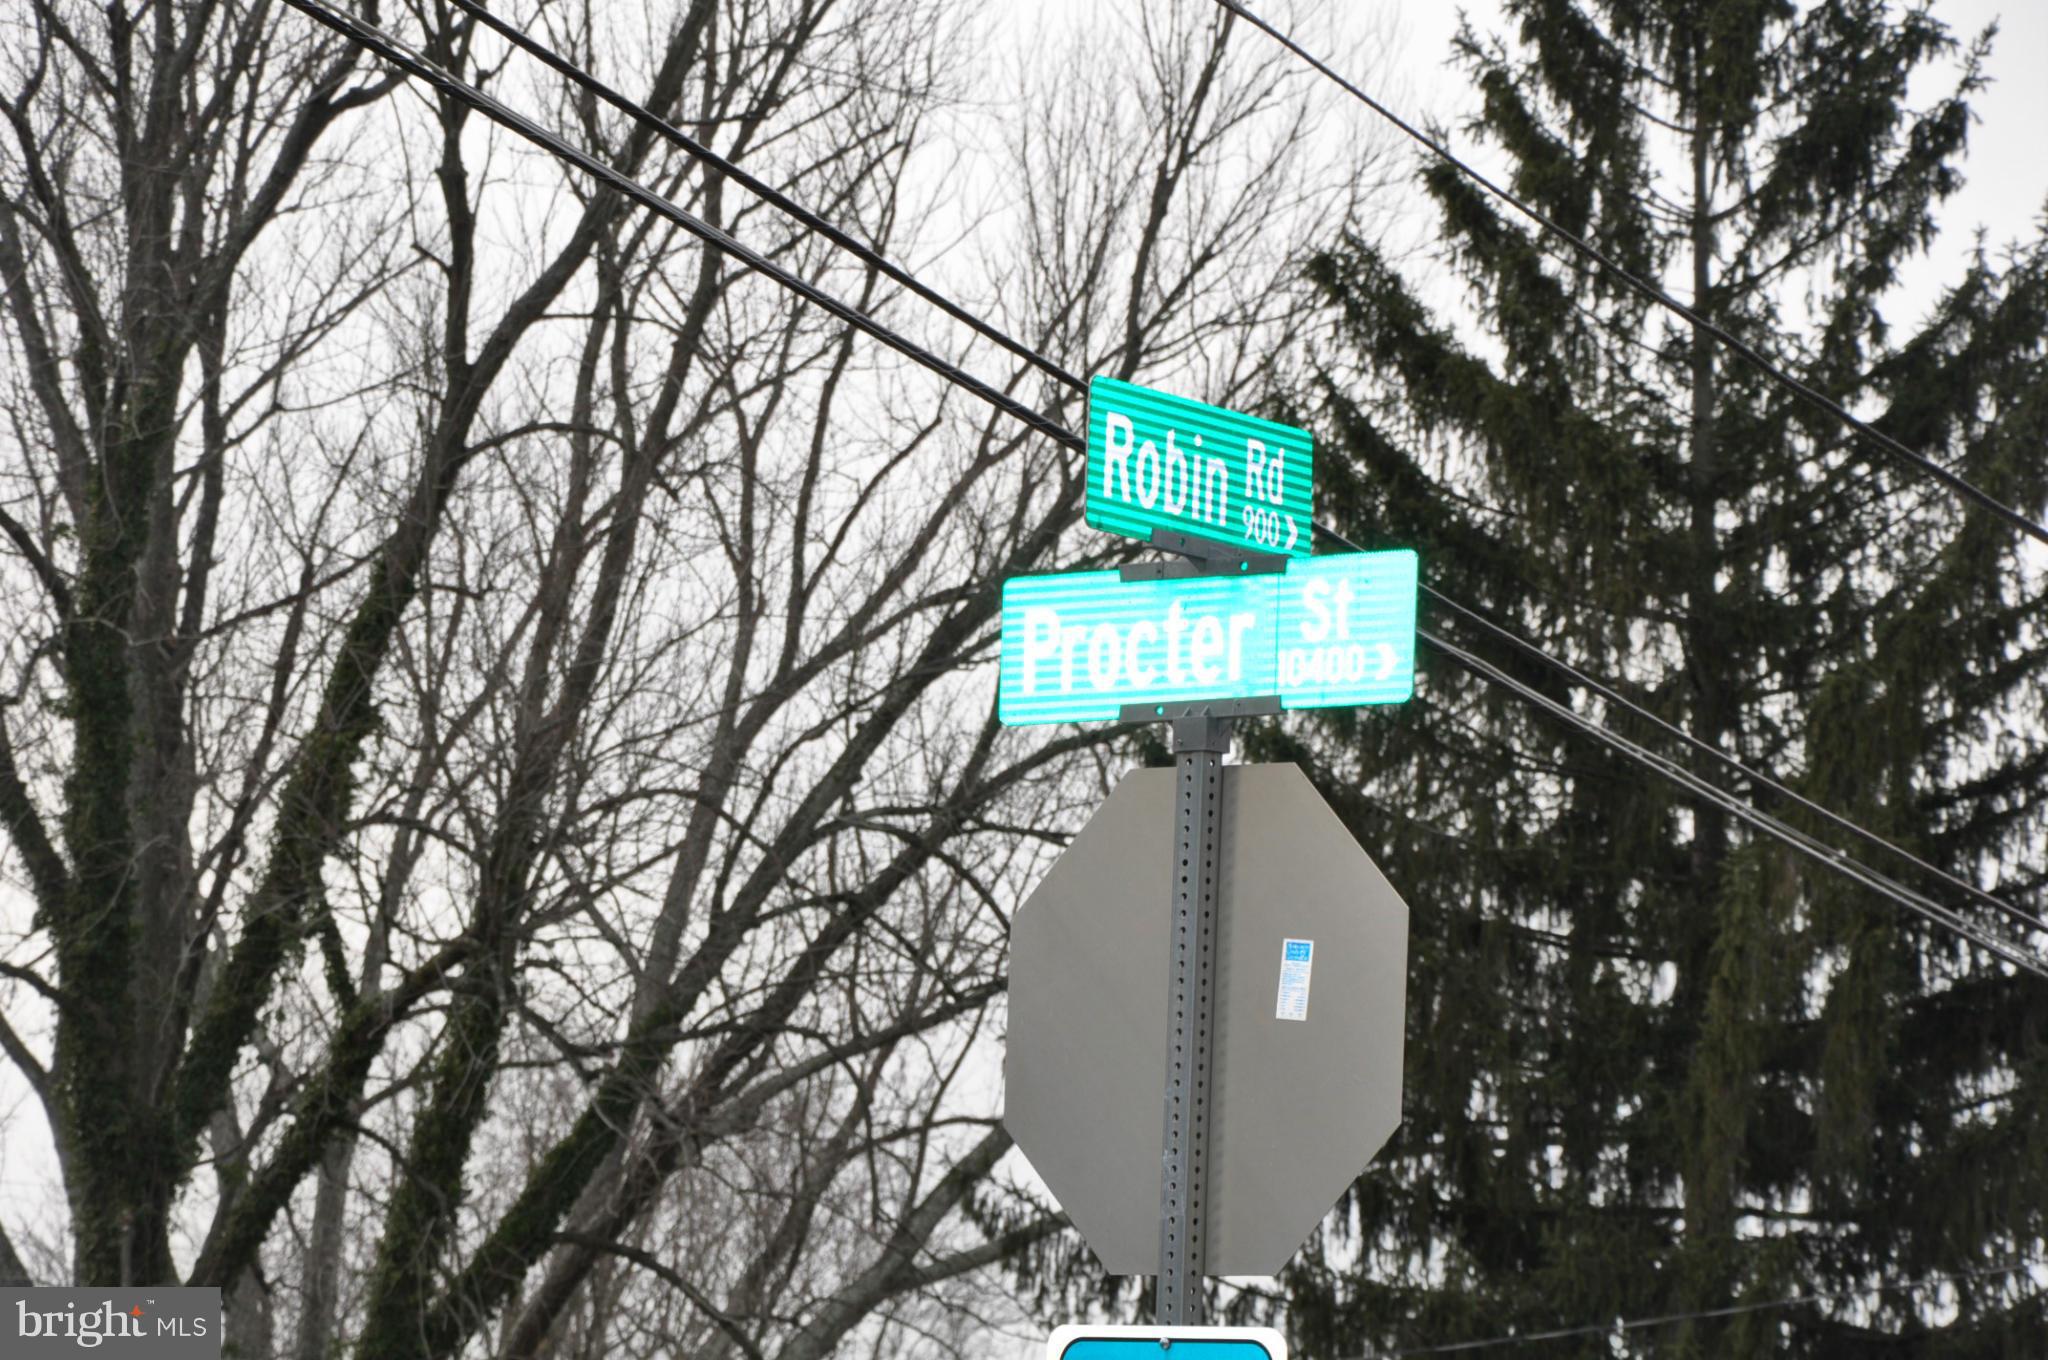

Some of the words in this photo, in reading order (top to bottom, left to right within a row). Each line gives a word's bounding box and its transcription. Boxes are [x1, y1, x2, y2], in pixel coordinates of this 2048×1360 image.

[1103, 411, 1229, 527] Robin
[1245, 438, 1285, 506] Rd
[1242, 504, 1280, 547] 900
[1022, 599, 1256, 695] Procter
[1299, 577, 1355, 643] St
[1278, 644, 1365, 687] 10400
